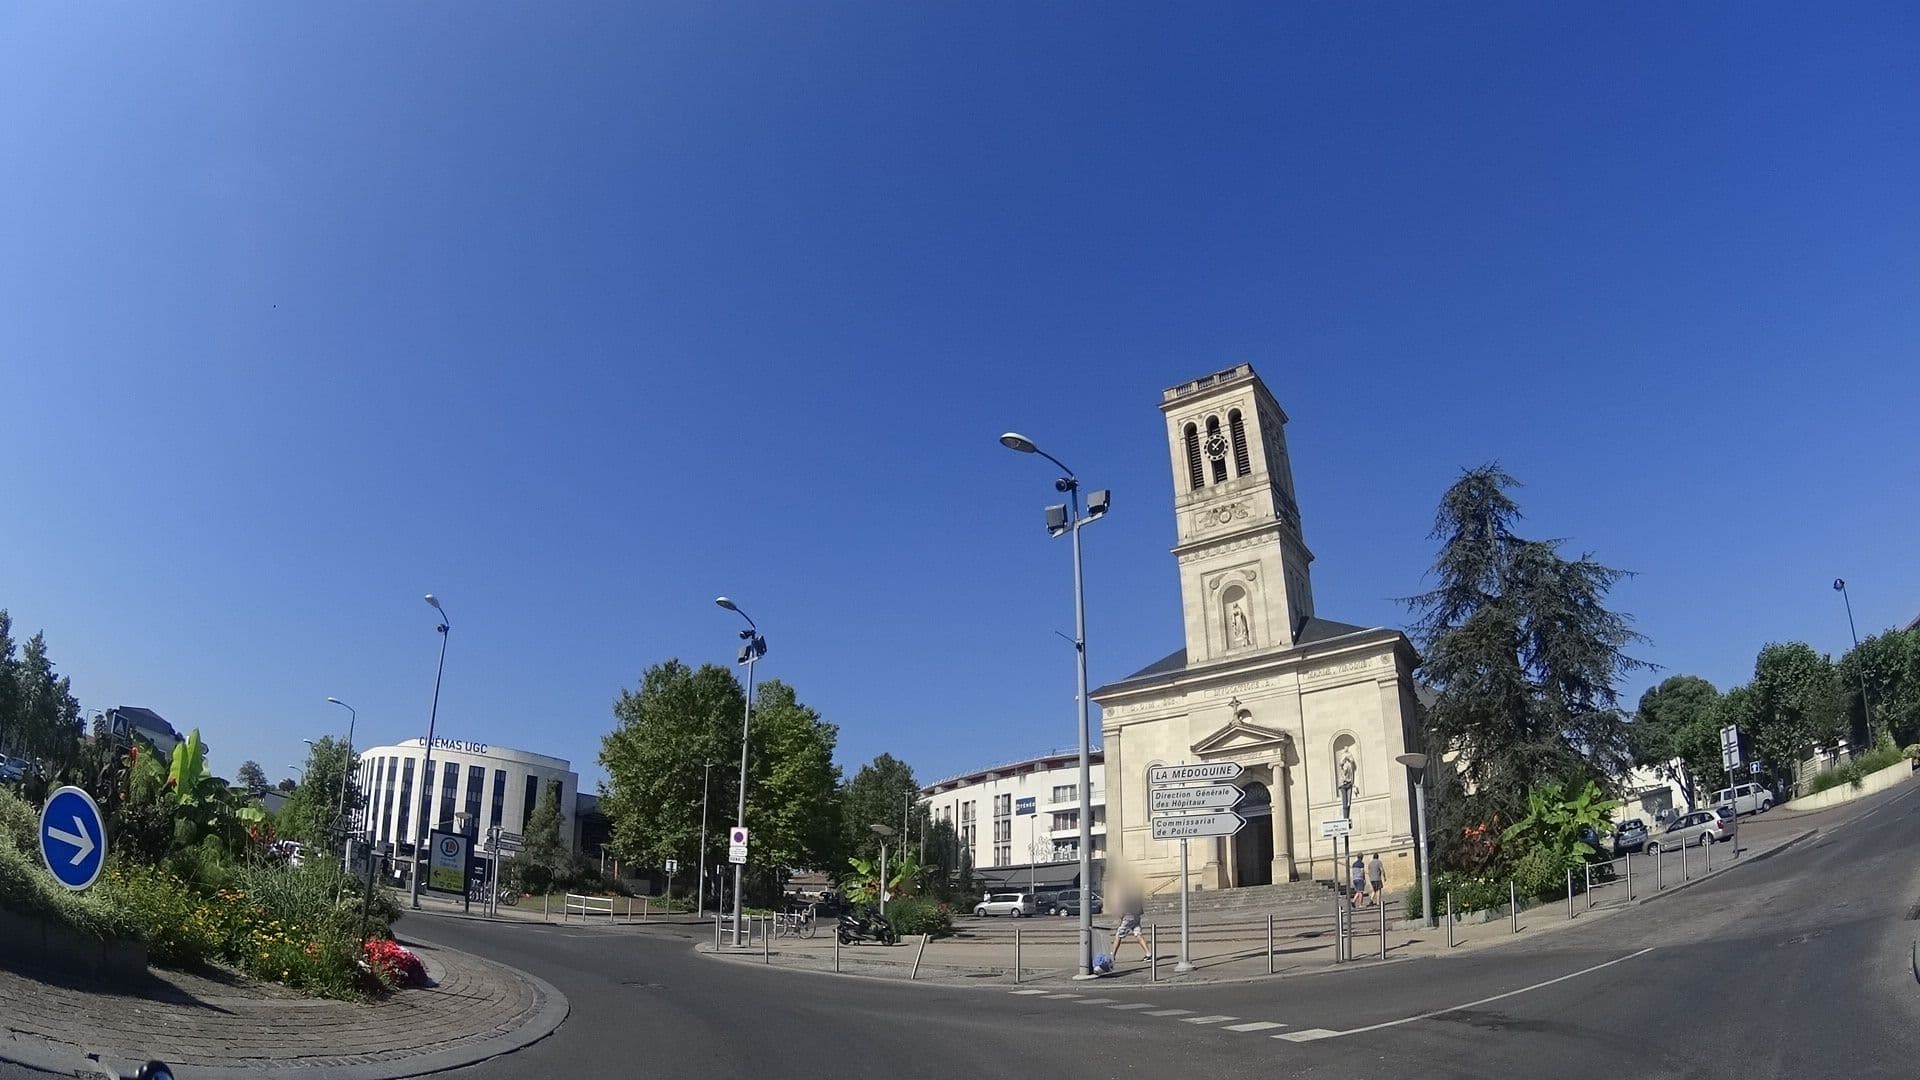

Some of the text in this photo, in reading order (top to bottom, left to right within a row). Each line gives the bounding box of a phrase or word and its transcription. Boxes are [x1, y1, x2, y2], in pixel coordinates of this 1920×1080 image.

[465, 741, 488, 754] UGC
[1156, 765, 1232, 780] LA MÉDOQUINE
[1155, 788, 1230, 800] Direction Générale
[1171, 799, 1206, 808] Hôpitaux
[1156, 817, 1216, 828] Commissariat
[1171, 827, 1198, 836] Police
